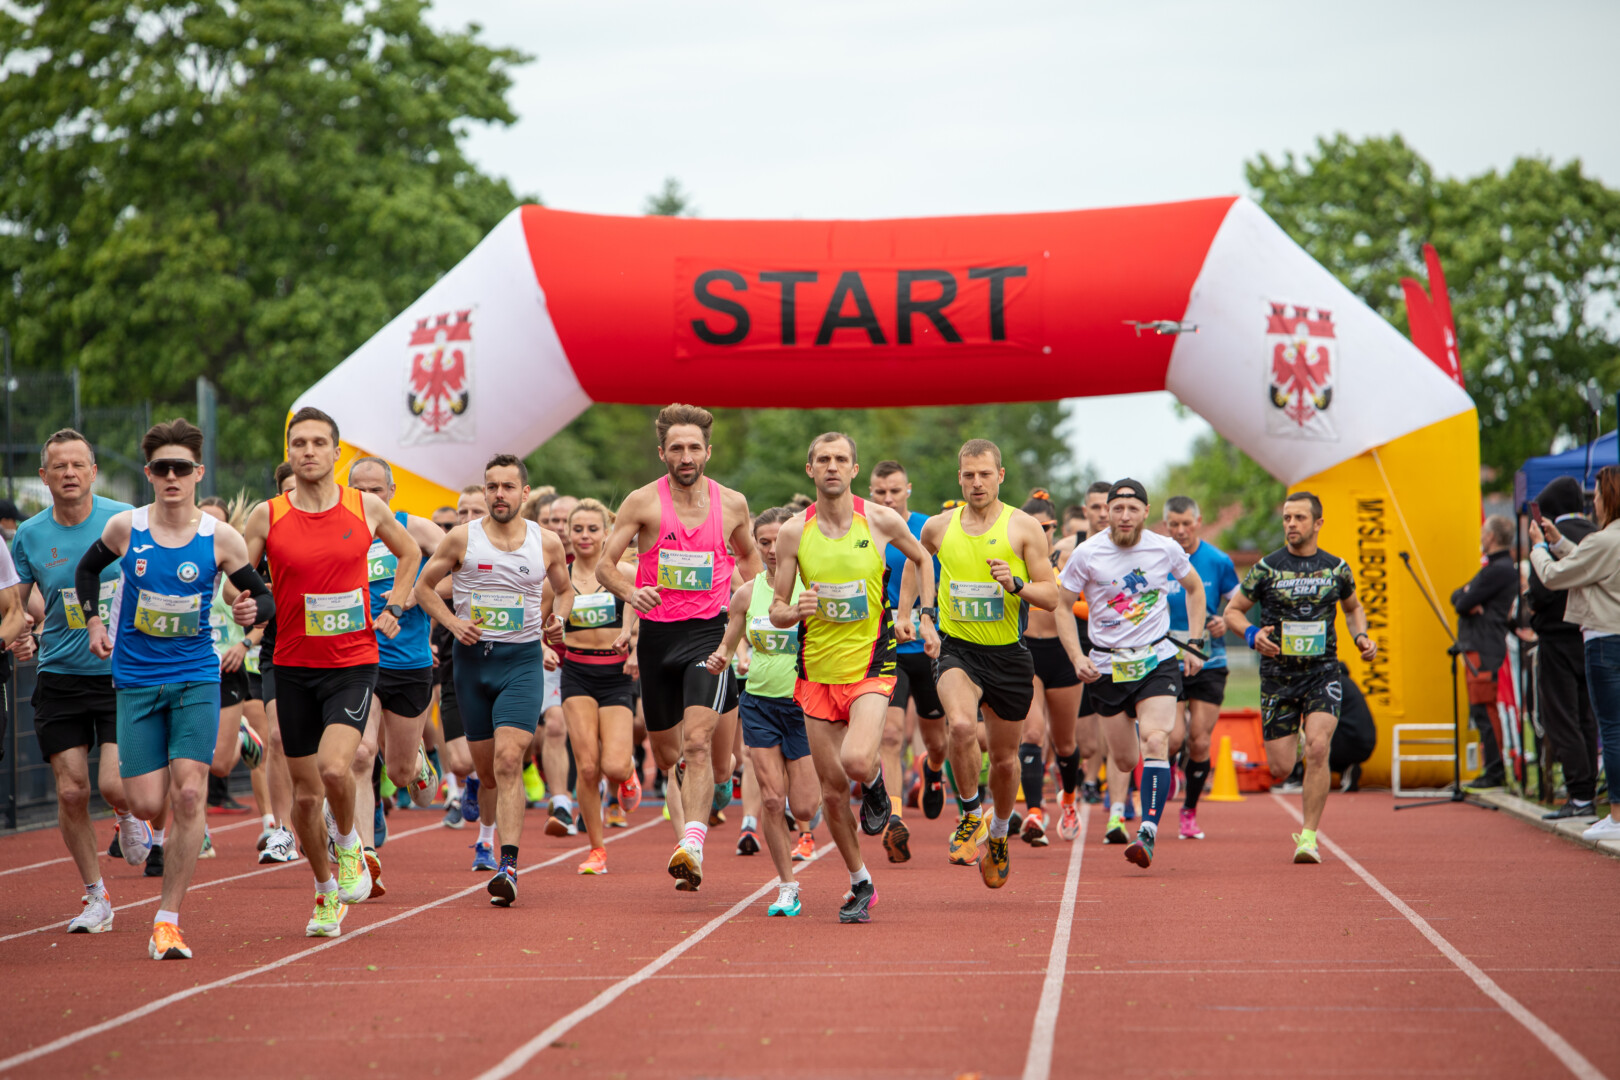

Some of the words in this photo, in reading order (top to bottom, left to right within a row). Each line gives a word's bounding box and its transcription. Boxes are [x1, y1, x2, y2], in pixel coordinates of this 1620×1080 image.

[690, 265, 1027, 346] START
[674, 570, 697, 586] 14
[1276, 577, 1332, 588] GORZOWSKA
[98, 604, 109, 620] 8
[576, 608, 608, 624] 105
[826, 602, 851, 618] 82
[958, 601, 992, 617] 111
[153, 615, 180, 632] 41
[323, 612, 350, 631] 88
[485, 611, 509, 627] 29
[765, 634, 789, 650] 57
[1294, 638, 1314, 652] 87
[1126, 662, 1147, 678] 53
